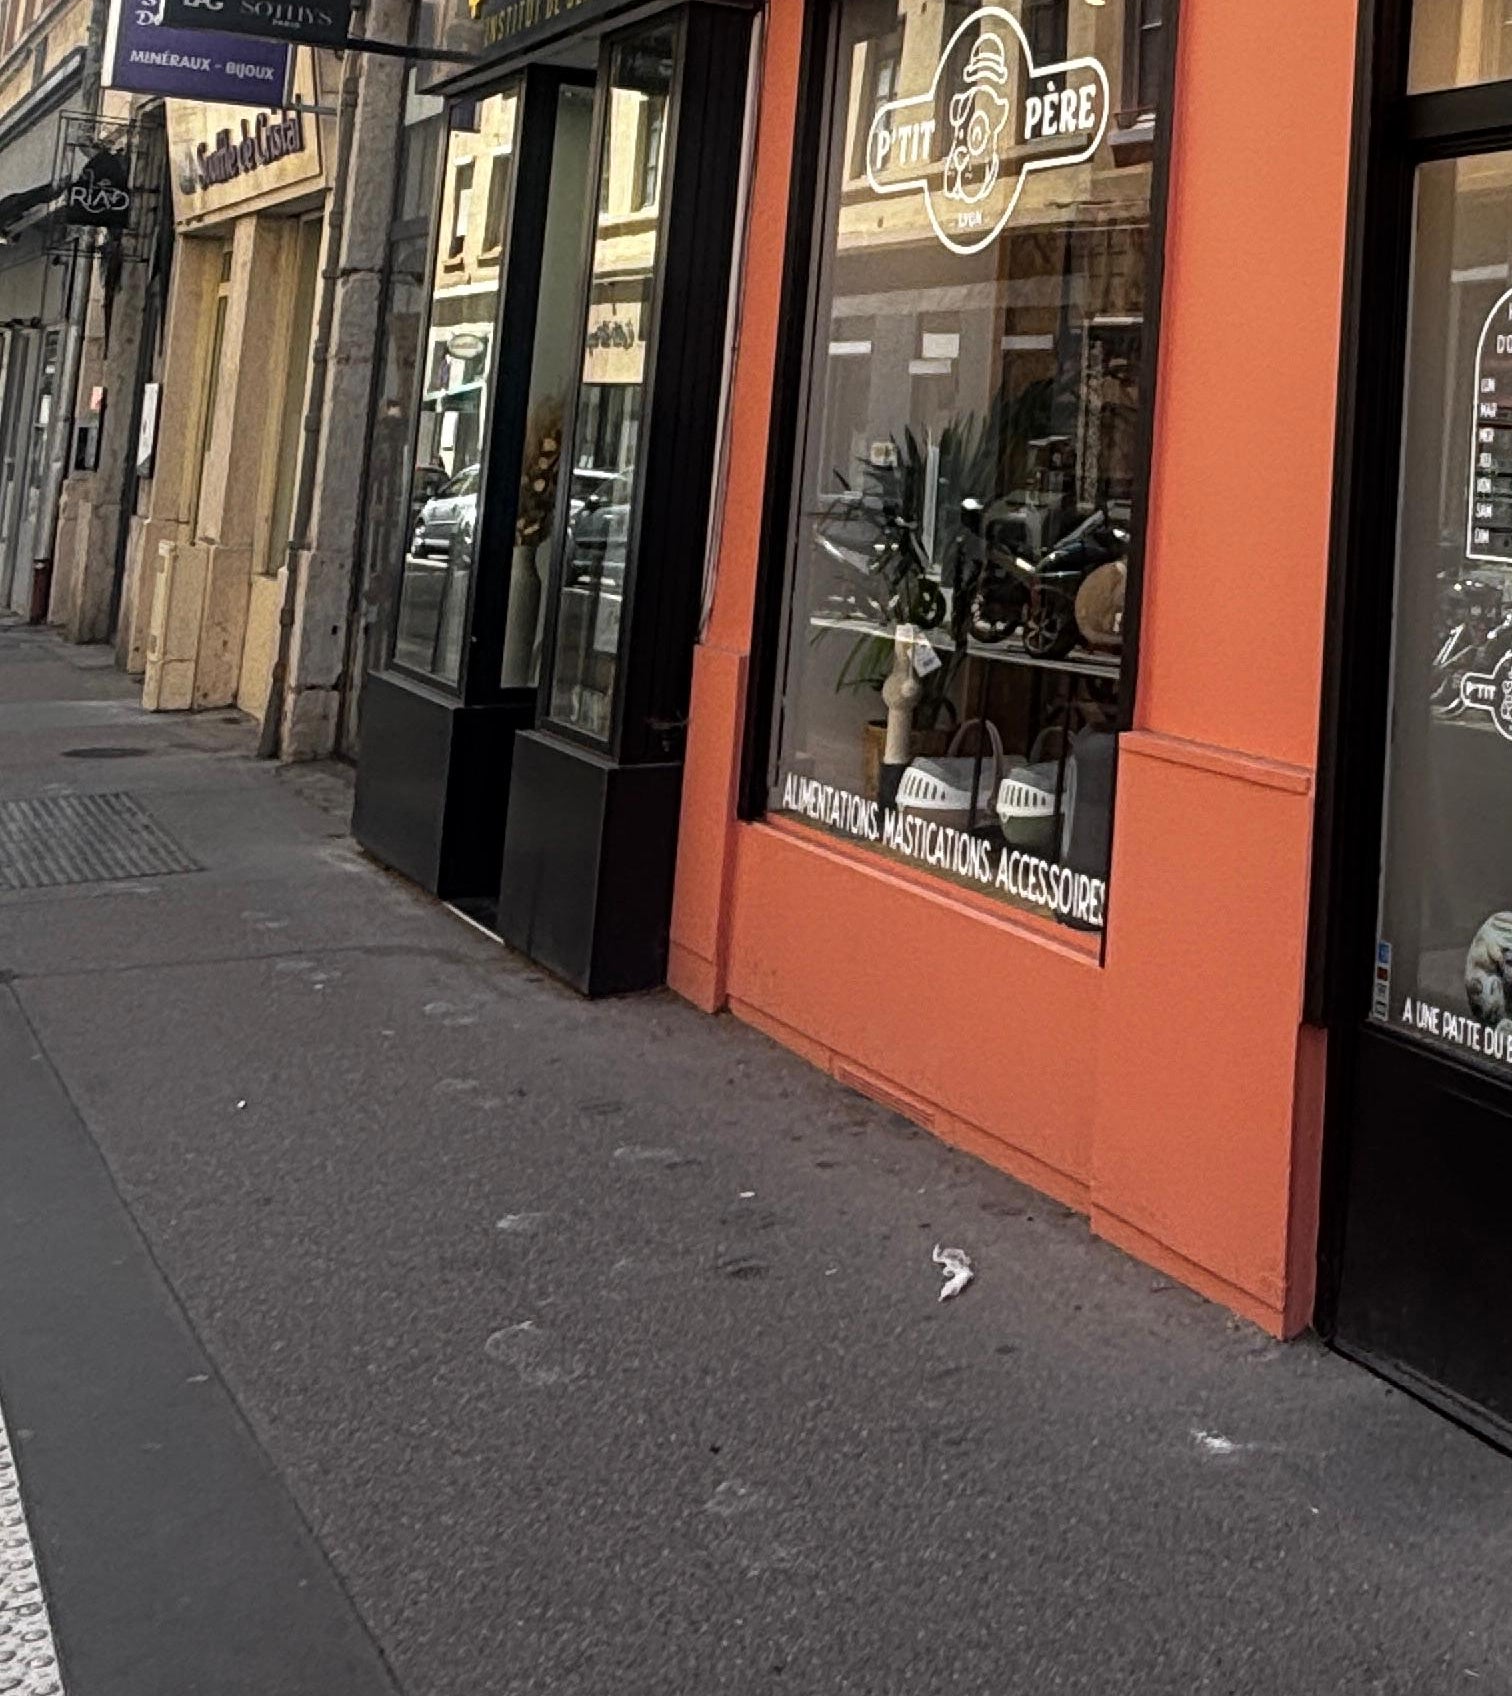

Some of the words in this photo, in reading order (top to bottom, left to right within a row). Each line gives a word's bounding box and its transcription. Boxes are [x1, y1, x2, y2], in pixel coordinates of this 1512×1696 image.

[129, 49, 211, 72] MINÉRAUX
[225, 62, 275, 80] BIJOUX
[876, 119, 936, 170] P'TIT
[1024, 82, 1096, 140] PÈRE
[1402, 997, 1414, 1024] A
[1416, 1000, 1440, 1035] UNE
[1442, 1010, 1482, 1053] PATTE
[1484, 1028, 1502, 1059] DU
